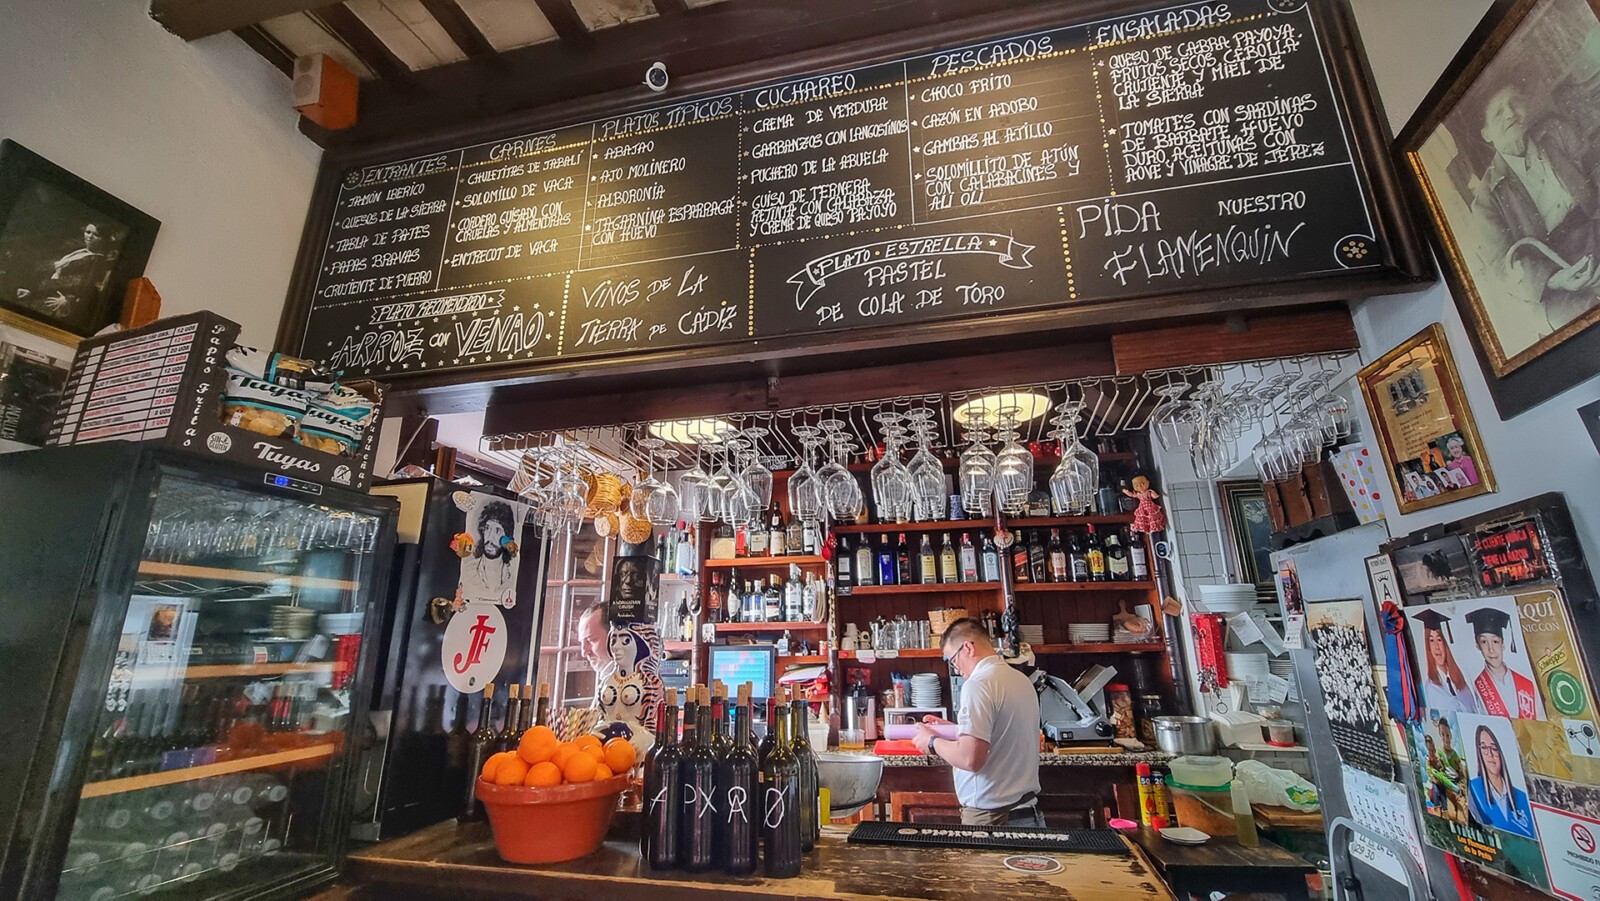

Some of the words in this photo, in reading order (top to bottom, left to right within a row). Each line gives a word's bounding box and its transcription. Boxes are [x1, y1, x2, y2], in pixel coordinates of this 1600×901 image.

[1096, 4, 1231, 45] ENSALADAS
[930, 36, 1053, 76] PESCADOS
[1109, 50, 1149, 69] QUESO
[1153, 46, 1172, 61] DE
[1177, 36, 1229, 56] CABRA
[1111, 62, 1167, 84] FRUTOS
[1224, 40, 1300, 63] CEBOLLA
[1192, 69, 1204, 82] Y
[1211, 62, 1251, 81] MIEL
[1258, 57, 1285, 73] DE
[755, 74, 855, 108] CUCHAREO
[921, 83, 963, 103] CHOCO
[969, 73, 1012, 94] FRITO
[1119, 93, 1140, 110] LA
[1146, 84, 1204, 107] SIERRA
[602, 112, 659, 137] PLATOS
[753, 114, 794, 133] CREMA
[806, 109, 823, 123] DE
[829, 97, 888, 119] VERDURA
[922, 106, 960, 129] CAZÓN
[964, 106, 982, 122] EN
[988, 97, 1038, 117] ADOBO
[1121, 114, 1196, 138] TOMATES
[1203, 109, 1230, 126] CON
[1234, 93, 1317, 122] SARDINAS
[490, 134, 556, 160] CARNES
[752, 134, 822, 158] GARBANZOS
[825, 129, 846, 144] CON
[849, 119, 908, 142] LANGOSTINOS
[923, 134, 979, 155] GAMBAS
[982, 132, 999, 147] AL
[1122, 139, 1145, 152] DE
[1242, 114, 1304, 137] HUEVO
[1172, 137, 1256, 162] ACEITUNAS
[1263, 130, 1296, 148] CON
[604, 141, 655, 159] ABAJAO
[926, 155, 1006, 182] SOLOMILLITO
[1012, 153, 1032, 168] DE
[1040, 143, 1079, 162] ATÚN
[1126, 165, 1161, 183] AOVE
[1167, 161, 1174, 176] Y
[1181, 155, 1233, 175] VINAGRE
[1233, 152, 1258, 168] DE
[1264, 142, 1325, 165] JEREZ
[364, 156, 447, 183] ENTRANTES
[468, 165, 524, 184] CHULETITAS
[527, 162, 540, 173] DE
[600, 170, 623, 182] AJO
[627, 157, 686, 179] MOLINERO
[751, 164, 798, 184] PUCHERO
[801, 160, 818, 175] DE
[822, 157, 836, 172] LA
[839, 148, 889, 169] ABUELA
[926, 180, 952, 197] CON
[959, 164, 1056, 192] CALABACINES
[1069, 160, 1080, 176] Y
[462, 186, 517, 208] SOLOMILLO
[521, 184, 537, 197] DE
[544, 177, 574, 192] VACA
[750, 204, 797, 223] RETINTA
[800, 200, 821, 214] CON
[827, 188, 895, 211] CALABAZA
[752, 191, 784, 210] GUISO
[790, 188, 806, 202] DE
[810, 178, 870, 200] TERNERA
[928, 192, 955, 211] ALI
[960, 191, 984, 205] OLI
[342, 212, 378, 229] QUESOS
[379, 209, 394, 222] DE
[396, 207, 409, 220] LA
[410, 200, 447, 218] SIERRA
[456, 224, 500, 242] CIRUELAS
[504, 222, 511, 234] Y
[514, 213, 571, 234] ALMENDRAS
[458, 213, 496, 231] CORDERO
[500, 207, 537, 224] GUISADO
[542, 201, 564, 216] CON
[595, 208, 666, 232] TAGARNINA
[750, 223, 758, 237] Y
[761, 218, 795, 235] CREMA
[797, 216, 812, 230] DE
[815, 212, 843, 227] QUESO
[847, 202, 896, 223] PAYOYO
[1076, 199, 1162, 239] PIDA
[1218, 191, 1306, 216] NUESTRO
[336, 236, 368, 252] TABLA
[372, 232, 388, 245] DE
[392, 224, 430, 243] PATES
[592, 232, 614, 245] CON
[620, 225, 657, 241] HUEVO
[329, 258, 367, 275] PAPAS
[372, 248, 420, 268] BRAVAS
[451, 247, 506, 267] ENTRECOT
[505, 245, 522, 259] DE
[529, 239, 558, 255] VACA
[817, 250, 870, 276] PLATO
[885, 236, 982, 258] ESTRELLA
[379, 276, 394, 290] DE
[396, 270, 432, 288] PUERRO
[582, 279, 641, 308] VINOS
[647, 277, 672, 302] DE
[677, 266, 708, 297] LA
[865, 259, 946, 287] PASTEL
[379, 305, 414, 321] PLATO
[416, 294, 486, 317] RECOMENDADO
[816, 303, 843, 325] DE
[859, 291, 905, 316] COLA
[915, 287, 943, 309] DE
[955, 282, 1005, 305] TORO
[575, 316, 643, 347] TIERRA
[649, 323, 667, 340] DE
[678, 301, 737, 334] CÁDIZ
[204, 325, 225, 374] Papas
[330, 328, 424, 370] ARROZ
[456, 311, 545, 357] VENAO
[183, 383, 210, 446] Fritas
[209, 442, 228, 451] GLUTEN
[211, 434, 220, 442] SIN
[253, 442, 320, 472] Tuyas
[1521, 623, 1538, 632] NIC
[1539, 622, 1559, 631] CON
[1354, 844, 1364, 854] 29
[1365, 849, 1375, 860] 30
